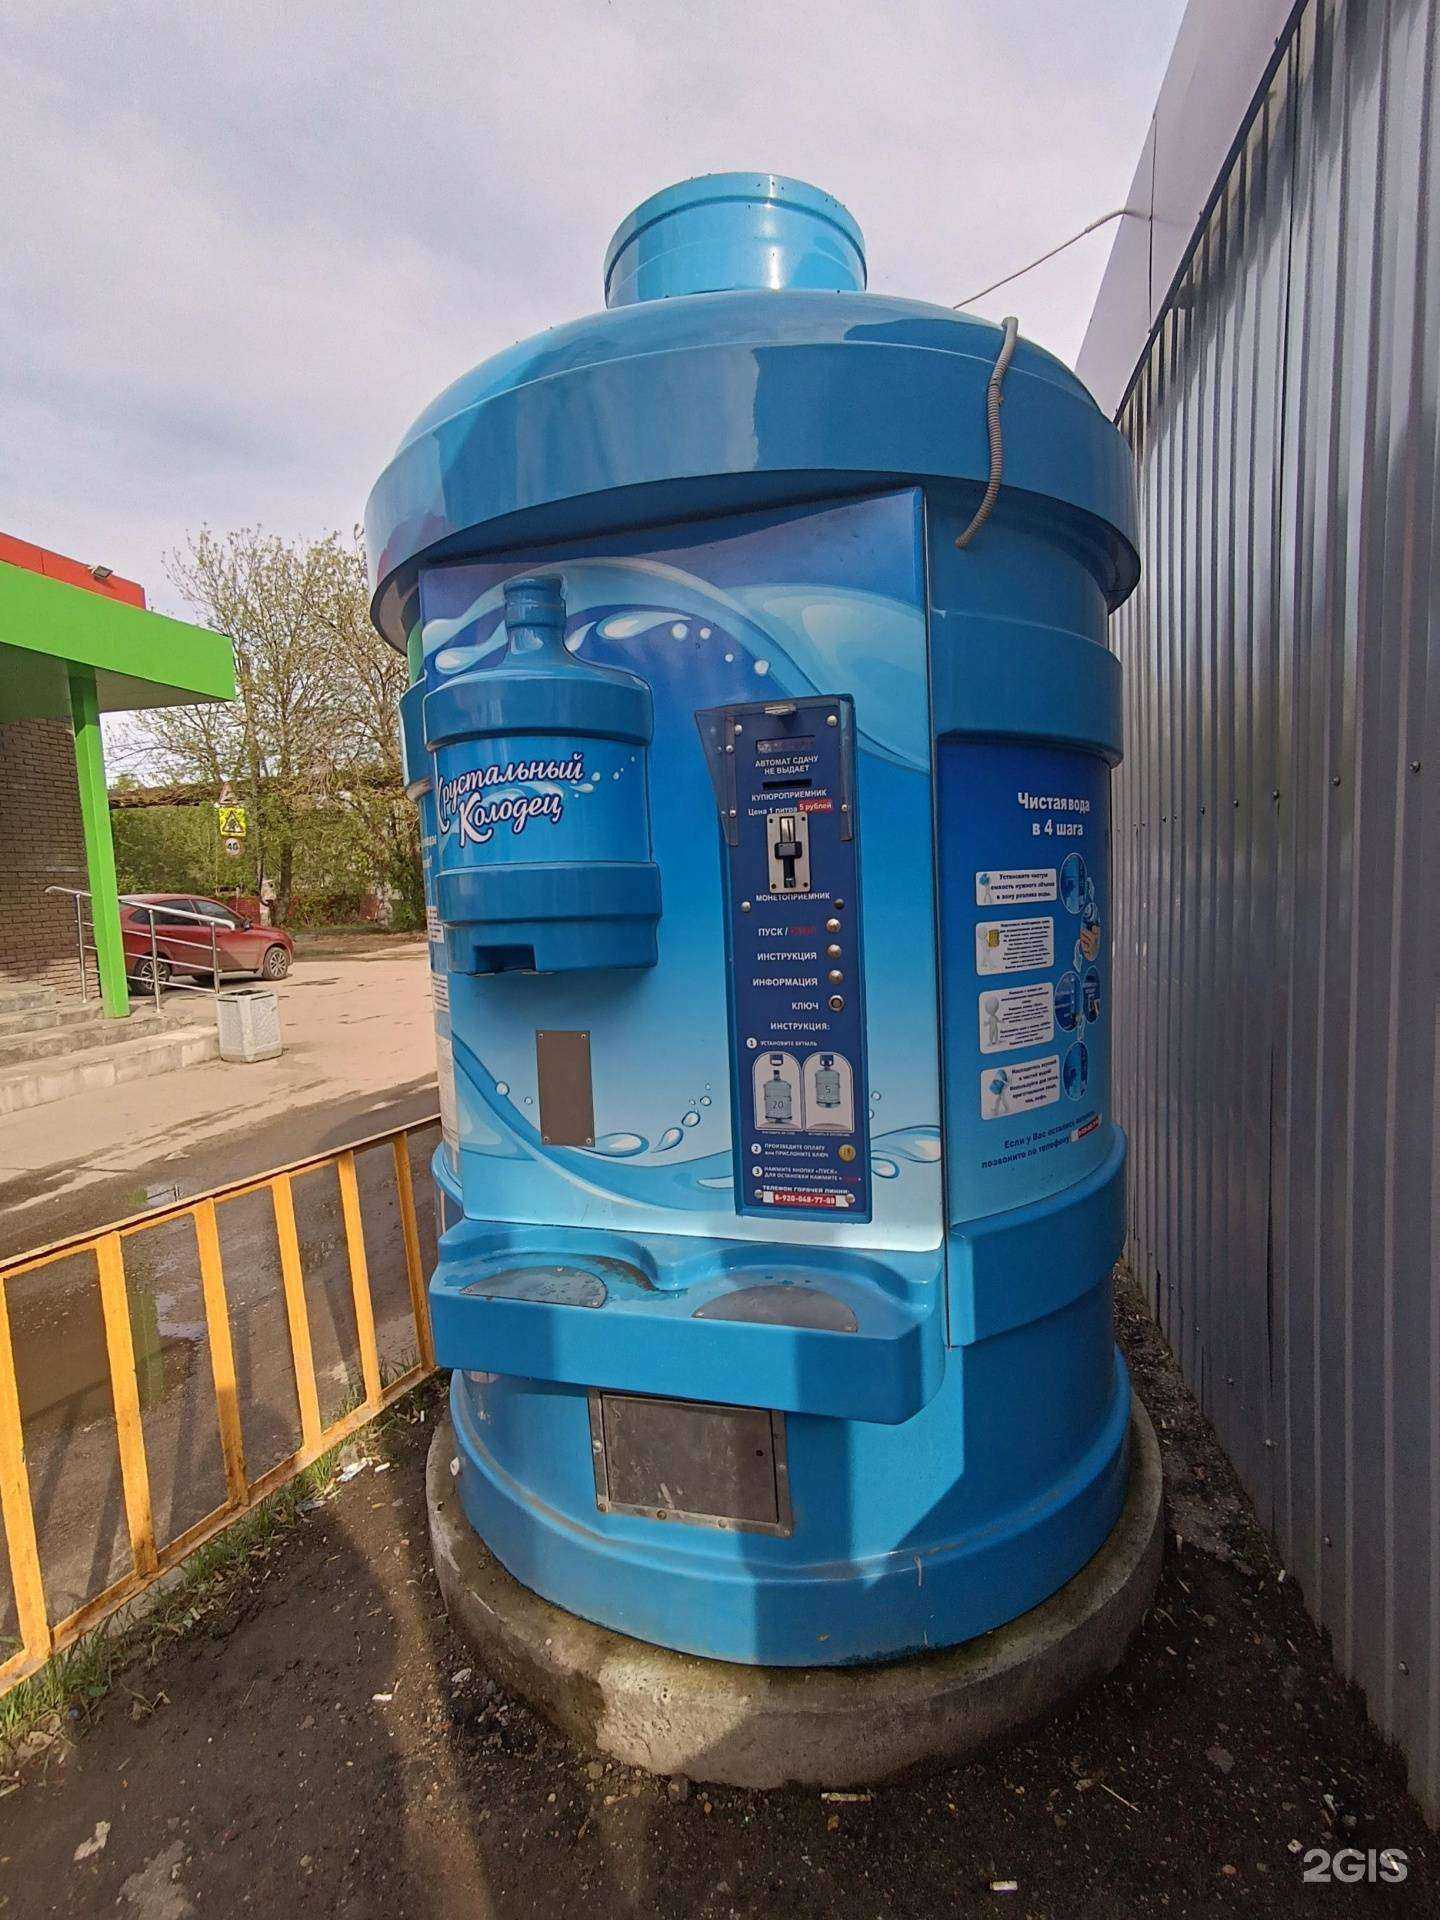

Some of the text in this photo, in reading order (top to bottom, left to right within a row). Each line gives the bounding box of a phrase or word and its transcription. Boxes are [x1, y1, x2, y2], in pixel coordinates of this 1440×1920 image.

[755, 755, 819, 767] АВТОМАТ СДАЧУ
[764, 765, 810, 775] НЕ ВЫДАЕТ
[751, 789, 828, 802] КУПЮРОПРИЕМНИК
[1018, 792, 1090, 813] Чистая вода
[748, 807, 767, 816] Цена
[805, 801, 832, 811] рублей
[459, 792, 563, 848] Колодец
[1032, 819, 1084, 836] в 4 шага
[227, 842, 239, 851] 40
[756, 892, 830, 901] МОНЕТОПРИЕМНИК
[758, 927, 783, 936] ПУСК
[784, 927, 789, 936] /
[757, 952, 817, 962] ИНСТРУКЦИЯ
[752, 978, 818, 987] ИНФОРМАЦИЯ
[791, 1001, 819, 1010] КЛЮЧ
[770, 1022, 830, 1031] ИНСТРУКЦИЯ:
[825, 1085, 831, 1095] 5
[772, 1100, 784, 1110] 20
